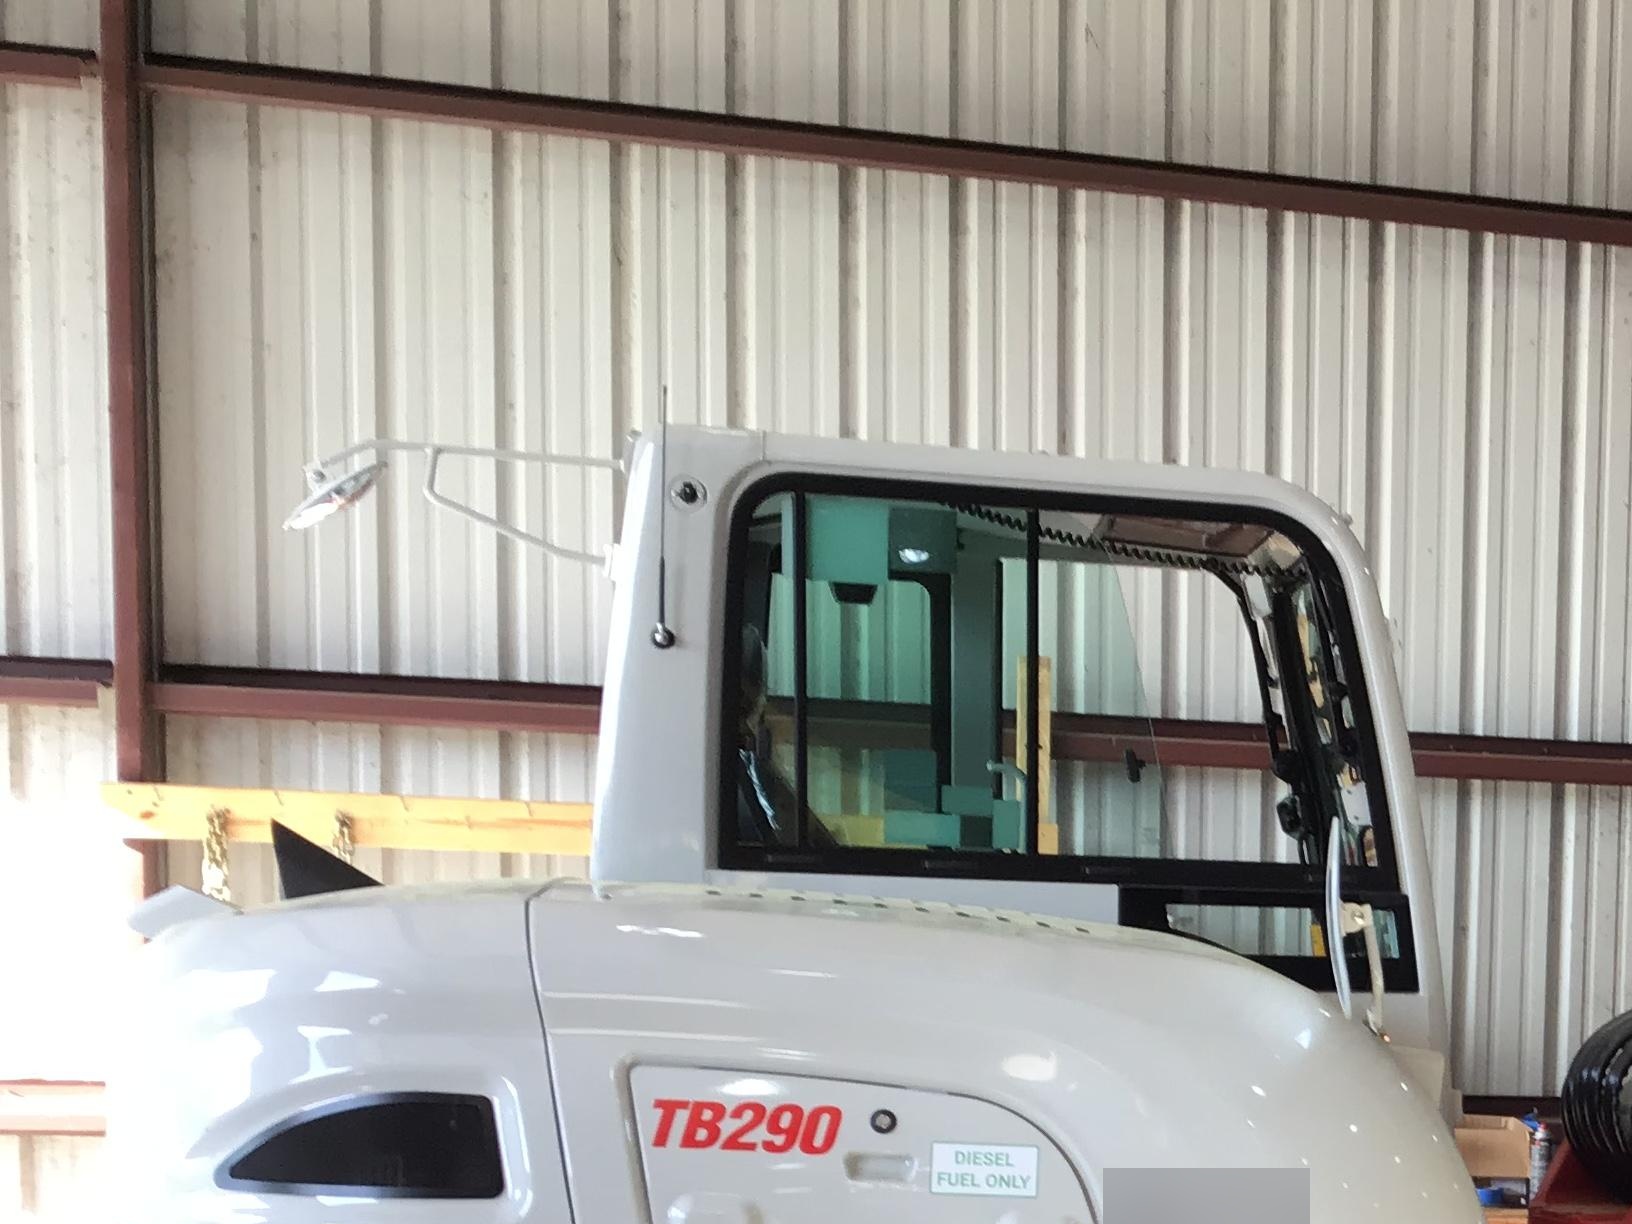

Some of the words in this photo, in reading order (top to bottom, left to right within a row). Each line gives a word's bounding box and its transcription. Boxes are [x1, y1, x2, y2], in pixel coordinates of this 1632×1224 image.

[651, 1098, 843, 1156] TB290
[954, 1150, 1015, 1167] DIESEL
[936, 1171, 981, 1187] FUEL
[985, 1174, 1031, 1189] ONLY
